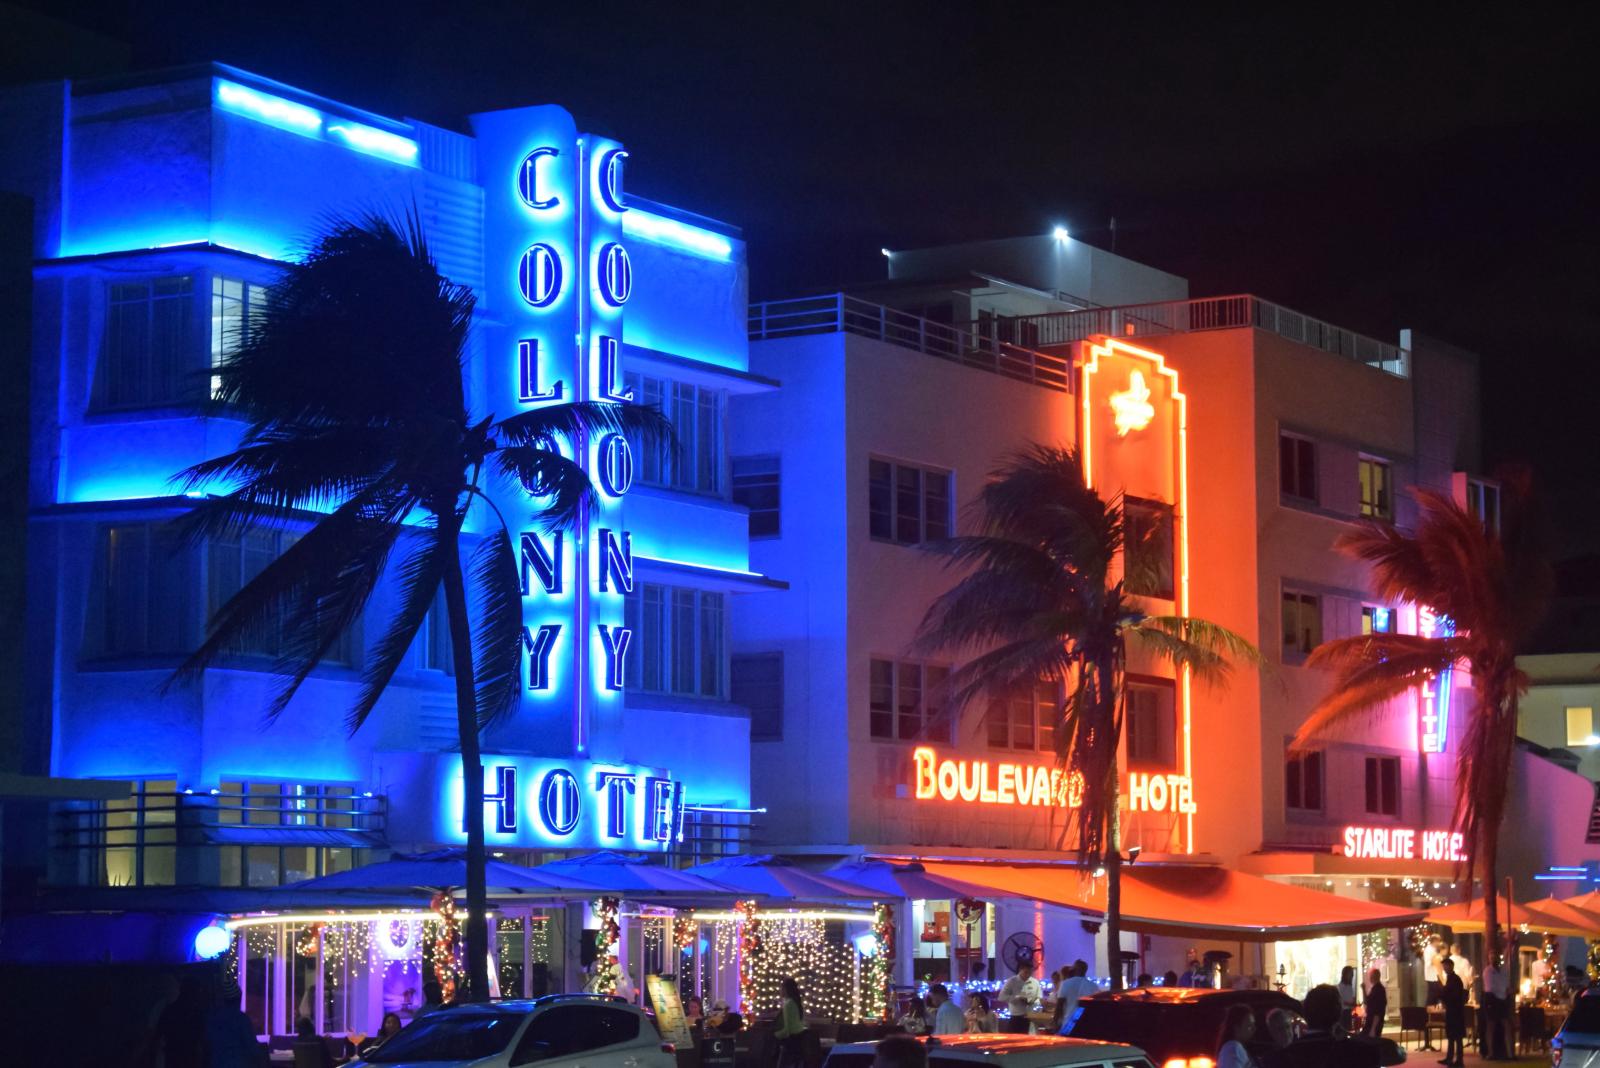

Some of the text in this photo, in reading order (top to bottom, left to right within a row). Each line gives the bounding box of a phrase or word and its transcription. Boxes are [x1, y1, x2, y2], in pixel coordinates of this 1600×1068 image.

[598, 149, 633, 690] COLONY
[1419, 604, 1438, 752] STLITE
[1129, 772, 1197, 813] HOTEL
[1344, 826, 1414, 859] STARLITE
